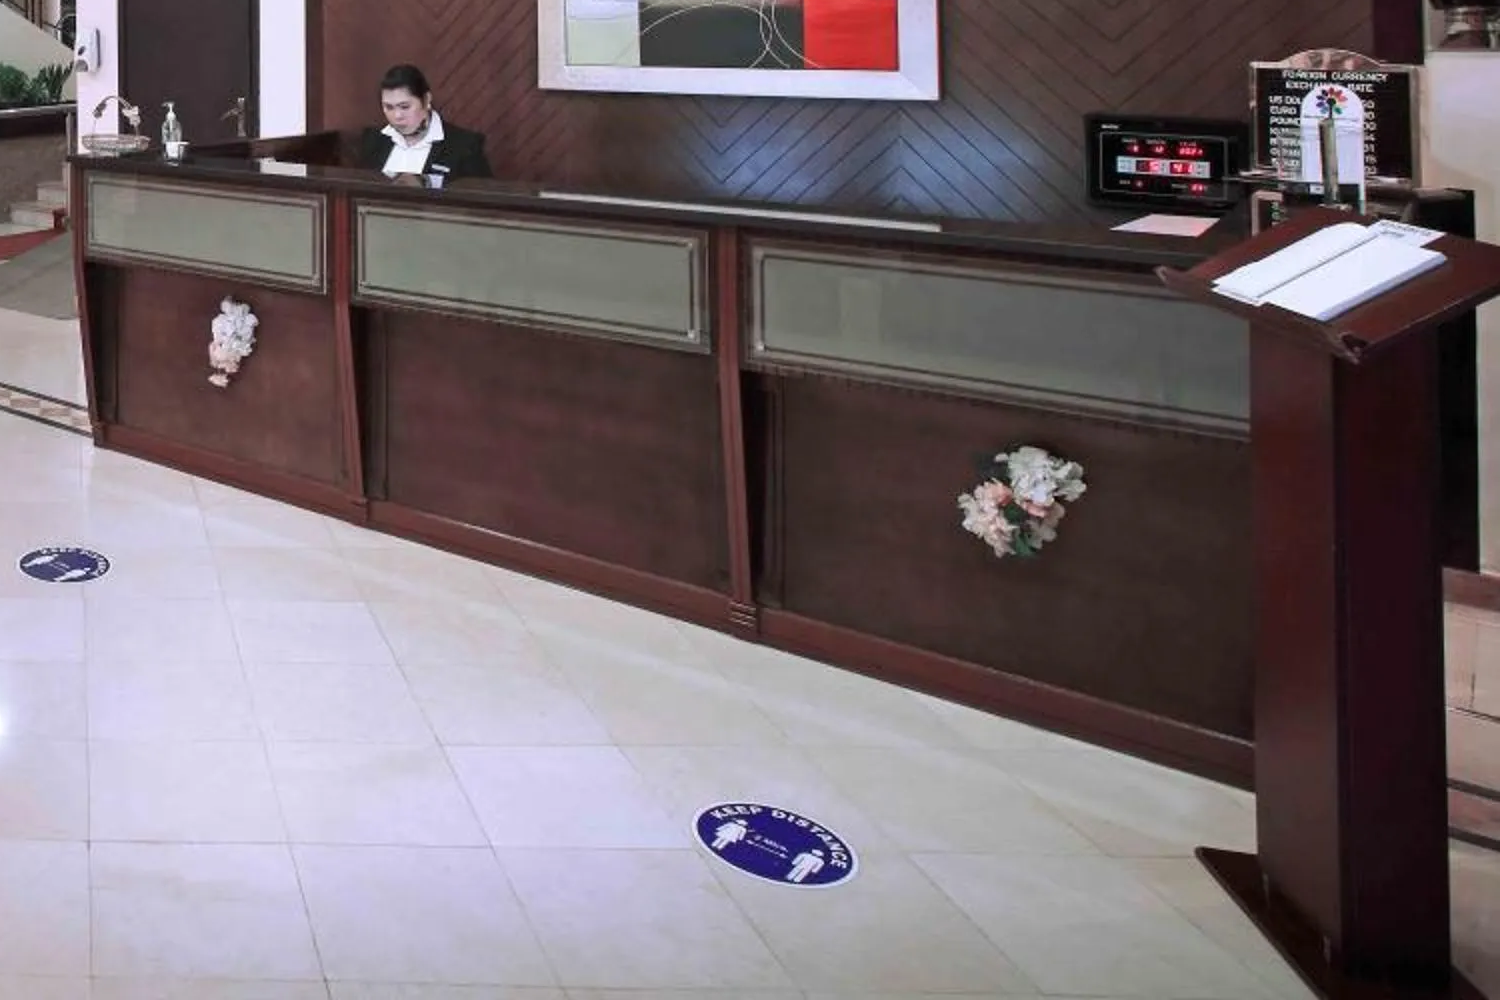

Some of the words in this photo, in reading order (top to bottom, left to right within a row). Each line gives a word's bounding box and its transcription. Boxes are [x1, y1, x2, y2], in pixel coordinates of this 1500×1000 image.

[1331, 71, 1388, 83] CURRENCY
[1269, 106, 1297, 115] EURO
[710, 804, 763, 820] KEEP
[771, 809, 848, 869] DISTANCE
